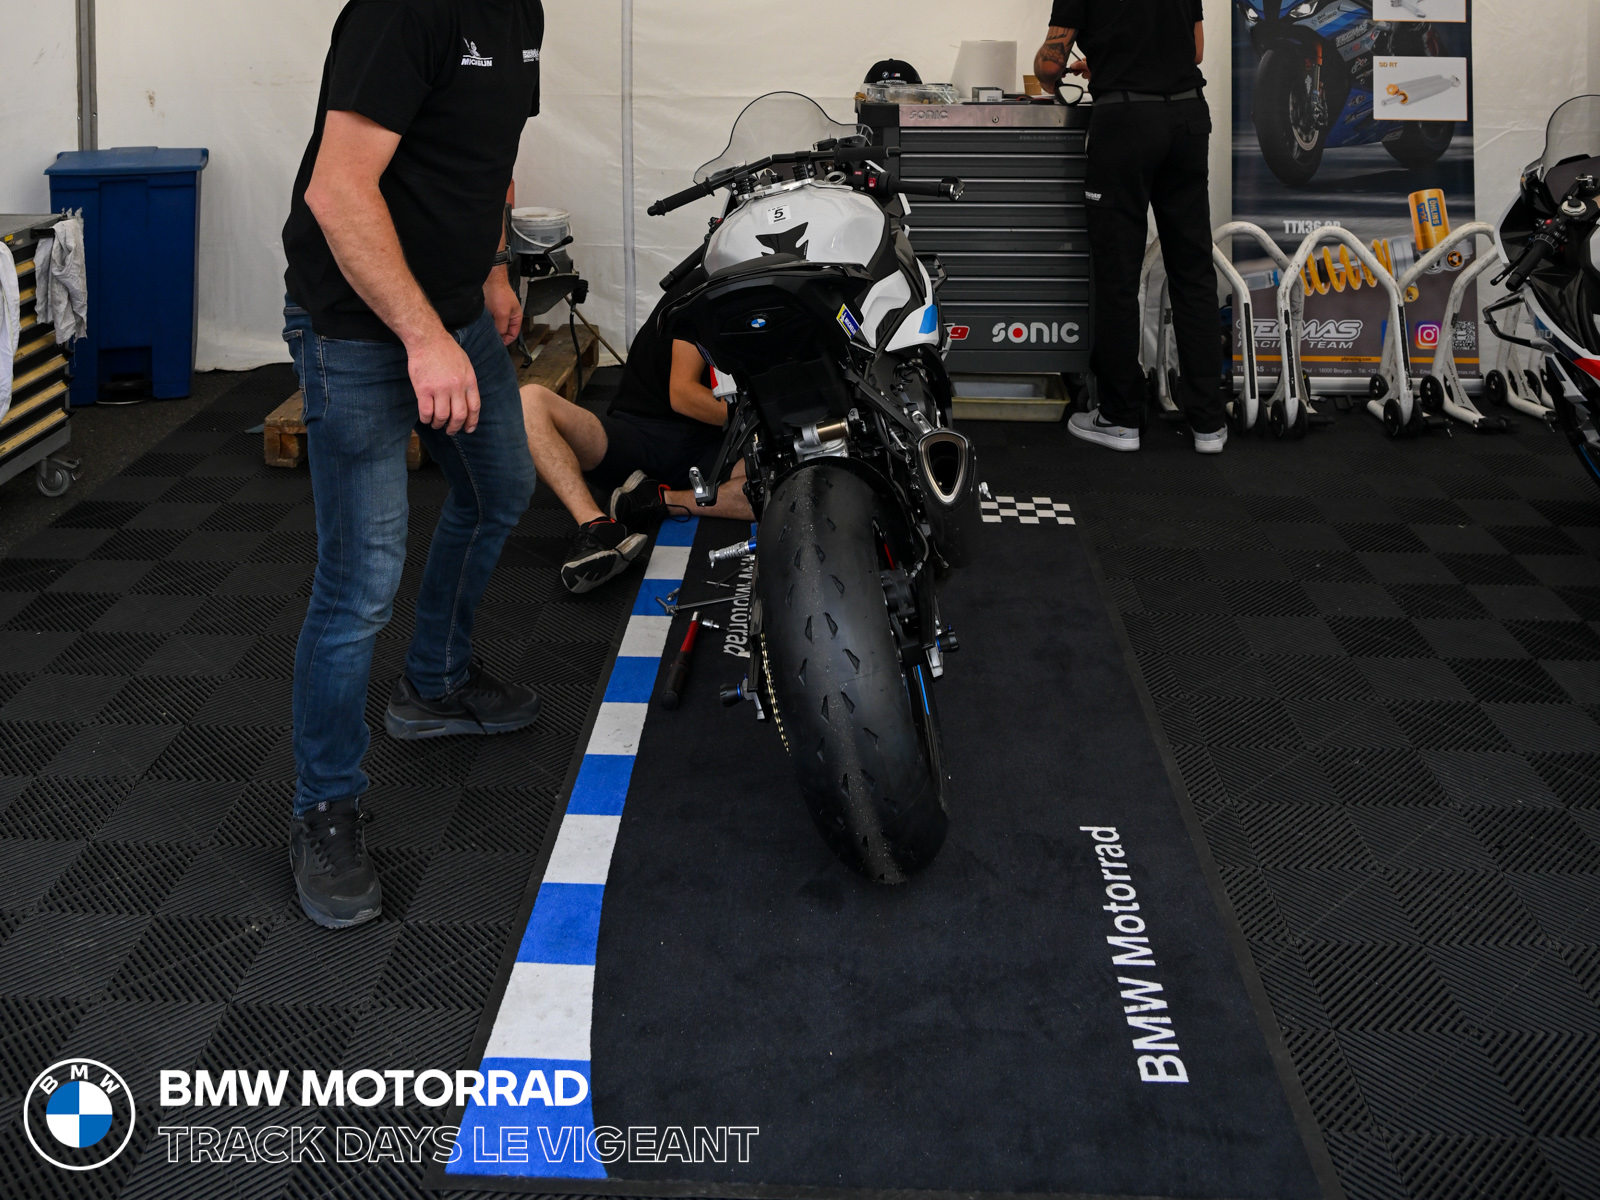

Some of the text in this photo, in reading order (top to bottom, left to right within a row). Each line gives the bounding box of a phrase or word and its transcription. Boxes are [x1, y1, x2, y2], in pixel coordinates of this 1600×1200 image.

[774, 208, 784, 219] 5
[992, 322, 1080, 343] SONIC
[1309, 341, 1354, 349] TEAM
[1079, 825, 1189, 1083] BMW Motorrad
